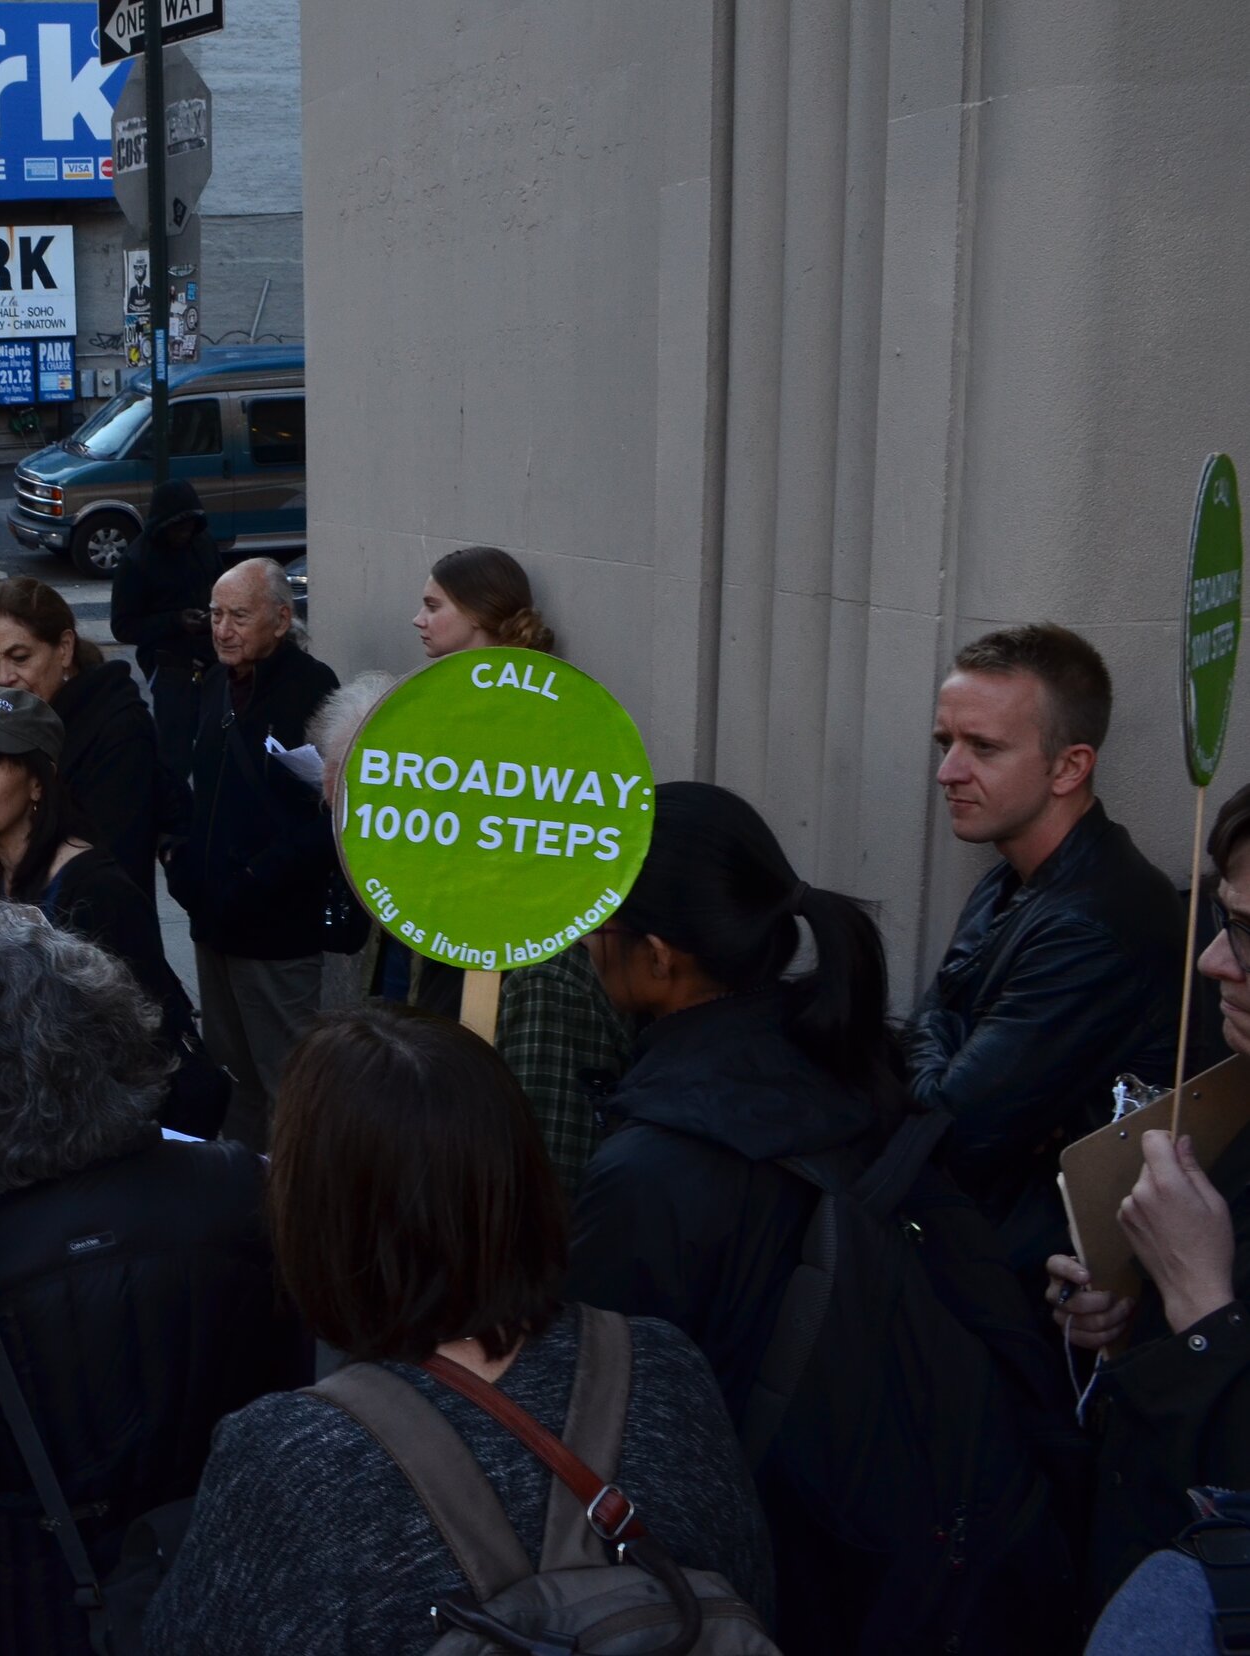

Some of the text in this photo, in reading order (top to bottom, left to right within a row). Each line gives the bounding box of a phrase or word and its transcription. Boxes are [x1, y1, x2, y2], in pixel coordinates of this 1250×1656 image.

[116, 8, 146, 38] ONE
[165, 0, 202, 22] WAY
[67, 164, 90, 174] VISA
[27, 306, 54, 316] SOHO
[13, 319, 66, 330] CHINATOWN
[39, 342, 71, 362] PARK
[47, 362, 71, 371] CHARGE
[0, 370, 31, 384] 21.12
[471, 662, 561, 702] CALL
[359, 749, 652, 812] BROADWAY:
[355, 802, 622, 861] 1000 STEPS
[365, 876, 622, 970] city as living laboratory
